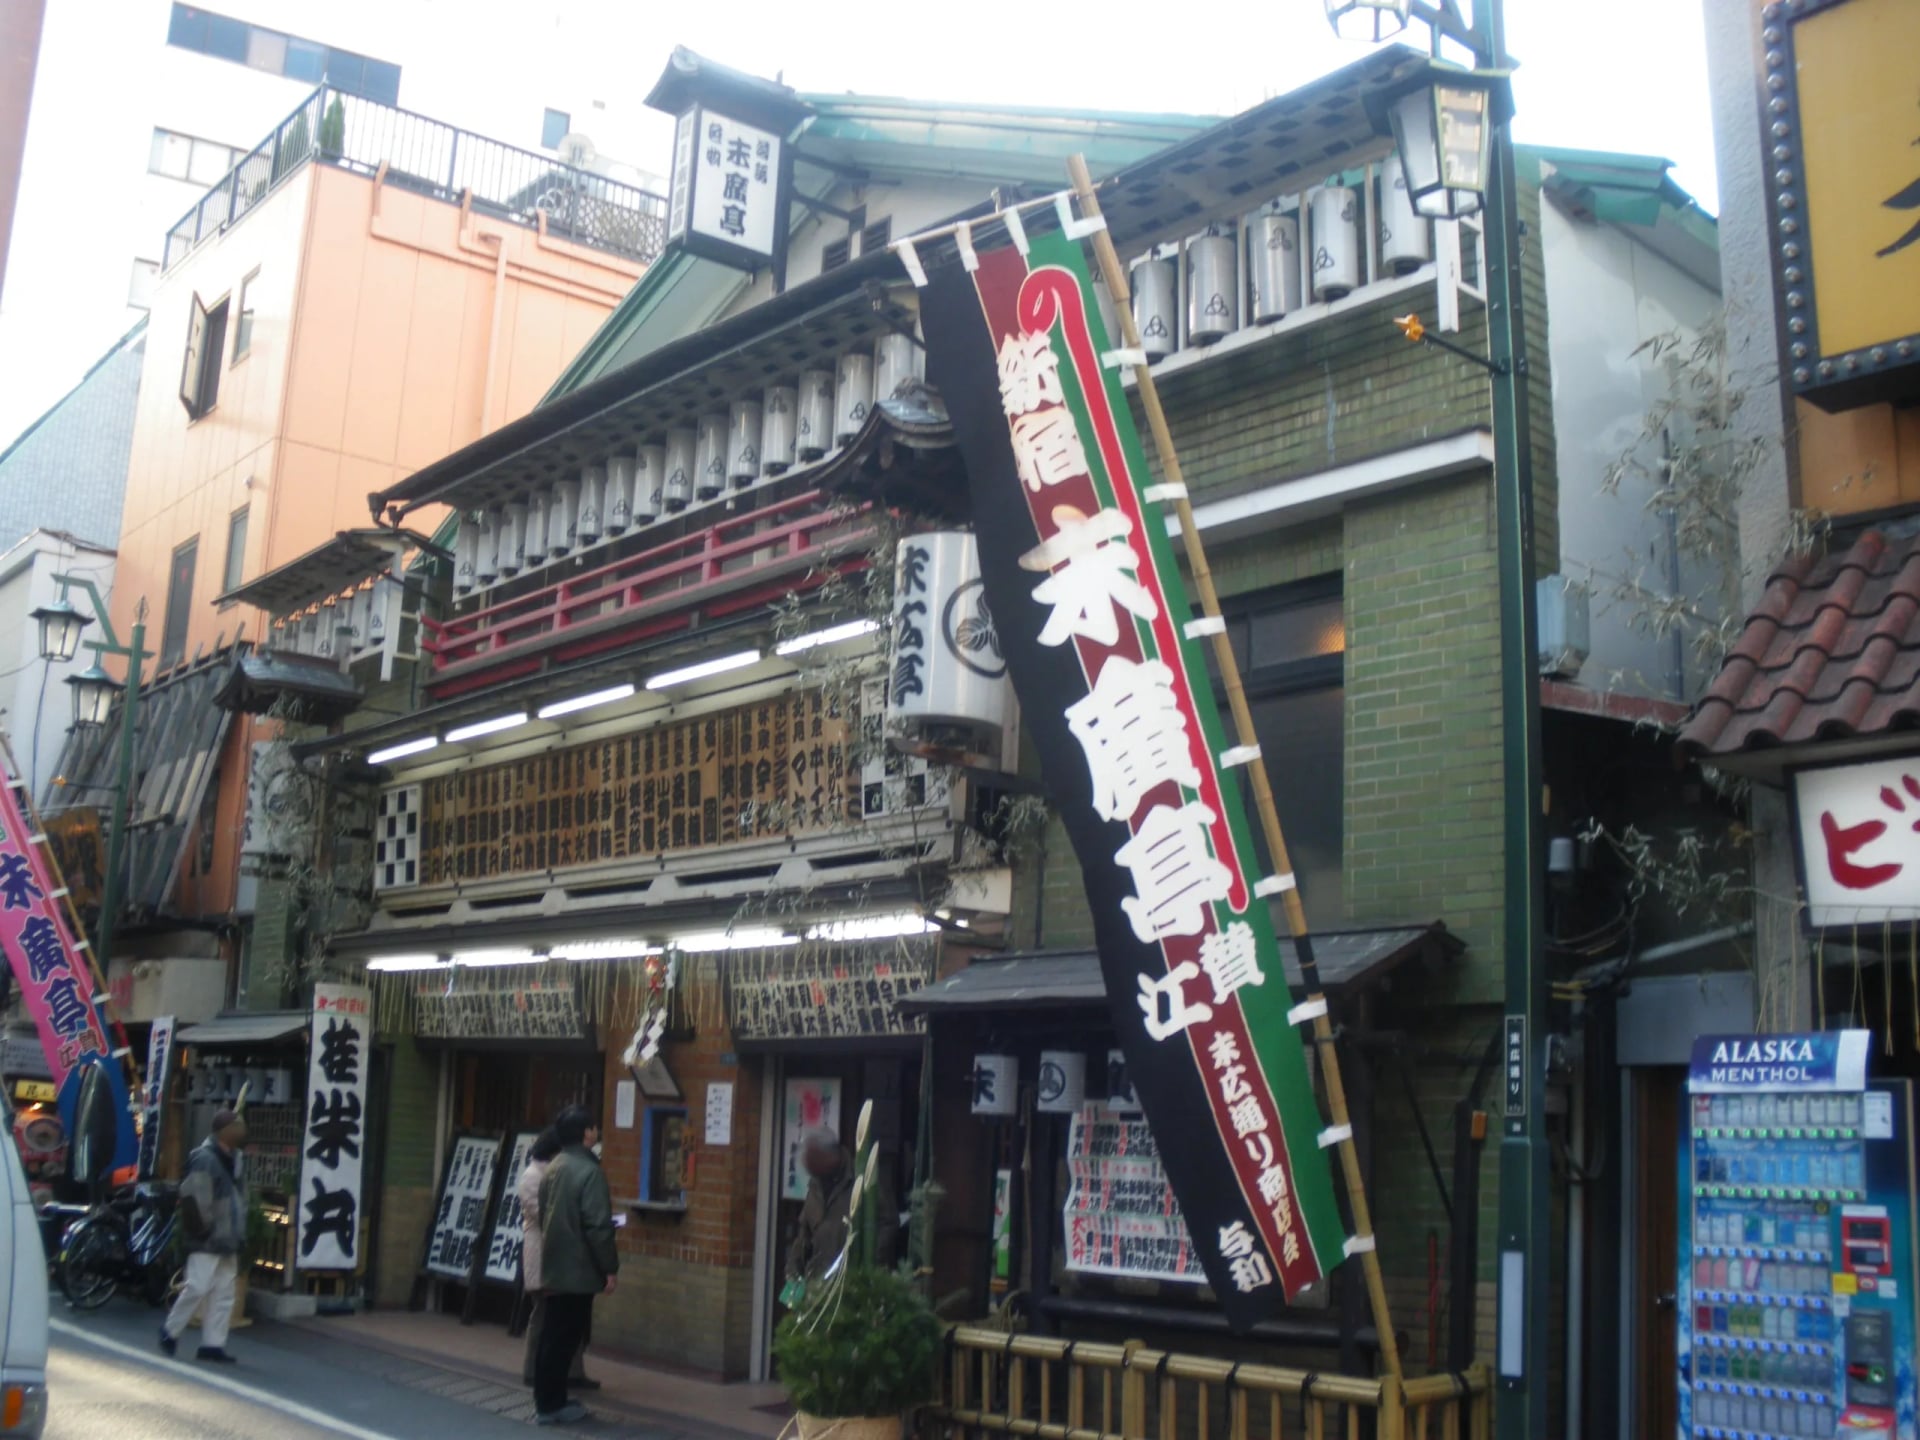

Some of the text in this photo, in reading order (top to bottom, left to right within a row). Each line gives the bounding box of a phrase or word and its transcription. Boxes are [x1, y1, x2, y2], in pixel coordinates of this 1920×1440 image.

[1821, 774, 1920, 890] ビ
[1711, 1038, 1815, 1065] ALASKA
[1711, 1065, 1813, 1083] MENTHOL
